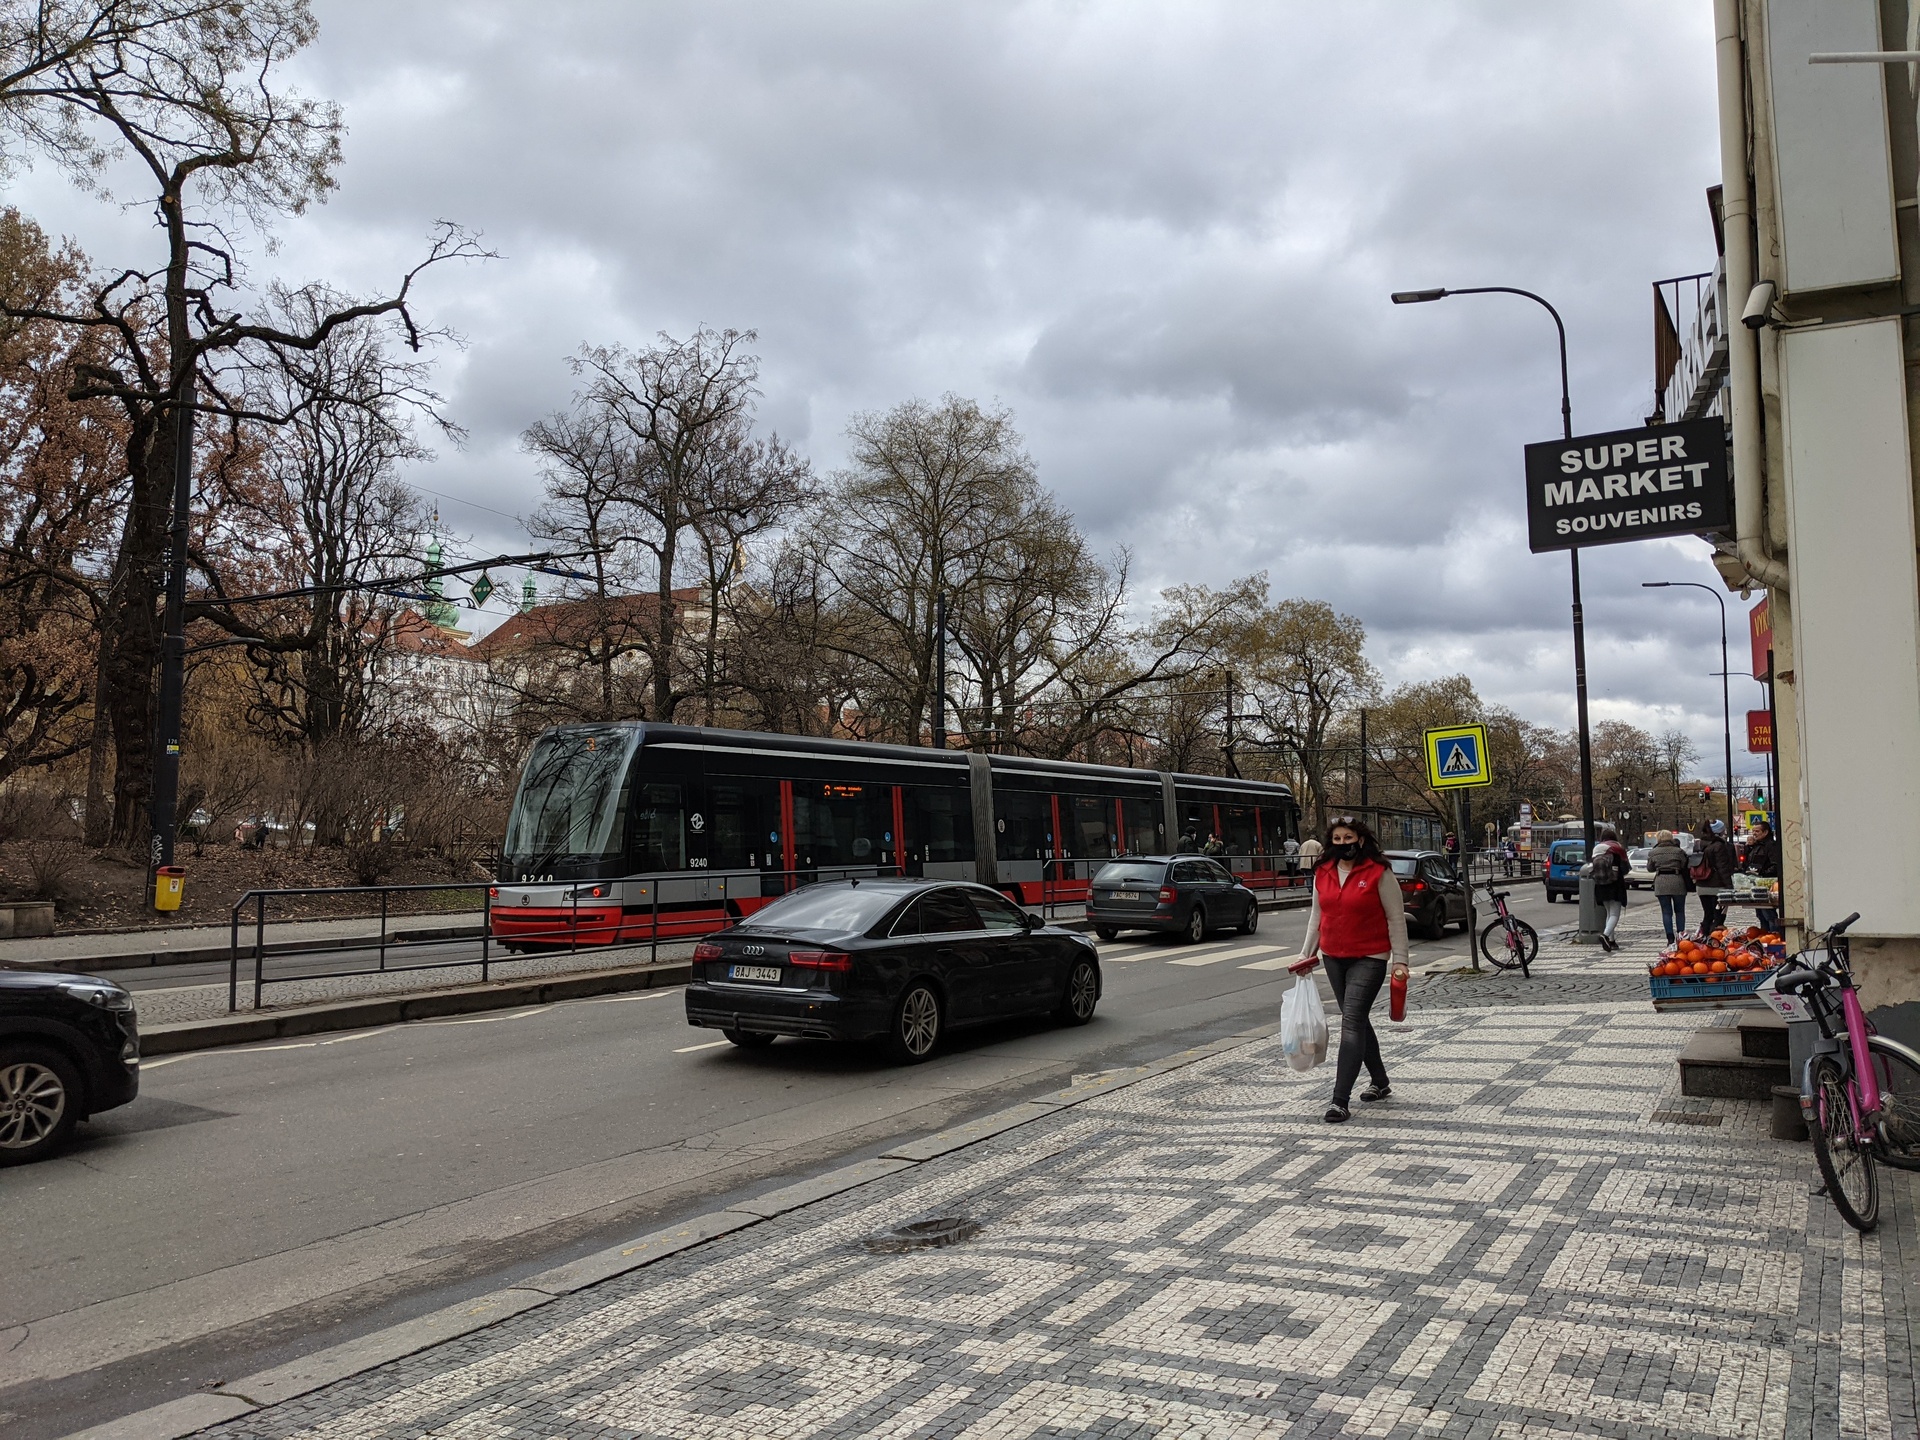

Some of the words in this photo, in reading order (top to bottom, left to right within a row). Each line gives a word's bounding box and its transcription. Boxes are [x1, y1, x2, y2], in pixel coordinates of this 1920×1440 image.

[1560, 435, 1688, 474] SUPER
[1544, 462, 1710, 507] MARKET
[1556, 502, 1702, 535] SOUVENIRS
[586, 737, 596, 751] 3
[690, 858, 708, 868] 9240
[521, 873, 553, 883] 9240
[735, 966, 750, 978] 8AJ
[756, 968, 777, 980] 3443
